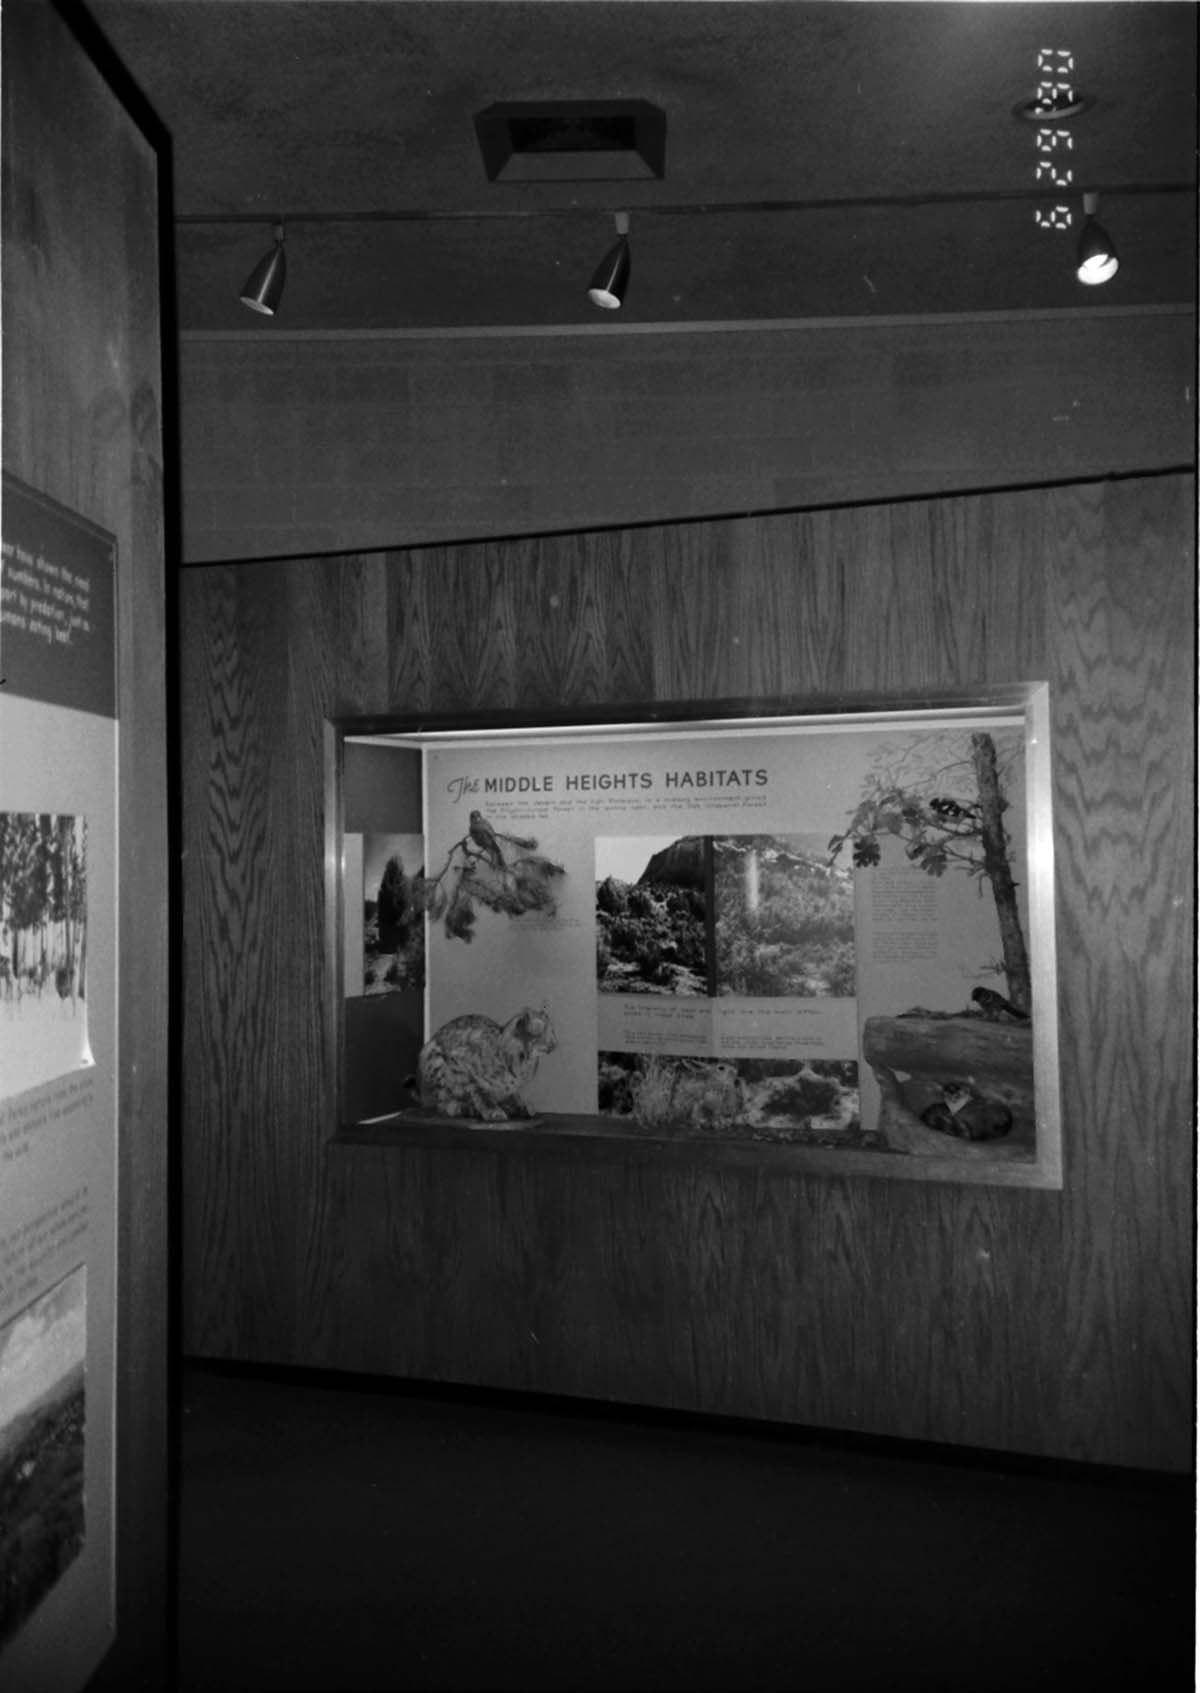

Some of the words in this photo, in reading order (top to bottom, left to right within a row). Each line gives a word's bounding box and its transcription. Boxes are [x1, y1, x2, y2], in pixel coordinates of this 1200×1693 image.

[447, 775, 480, 804] The
[484, 776, 553, 793] MIDDLE
[565, 772, 653, 791] HEIGHTS
[665, 769, 769, 789] HABITATS
